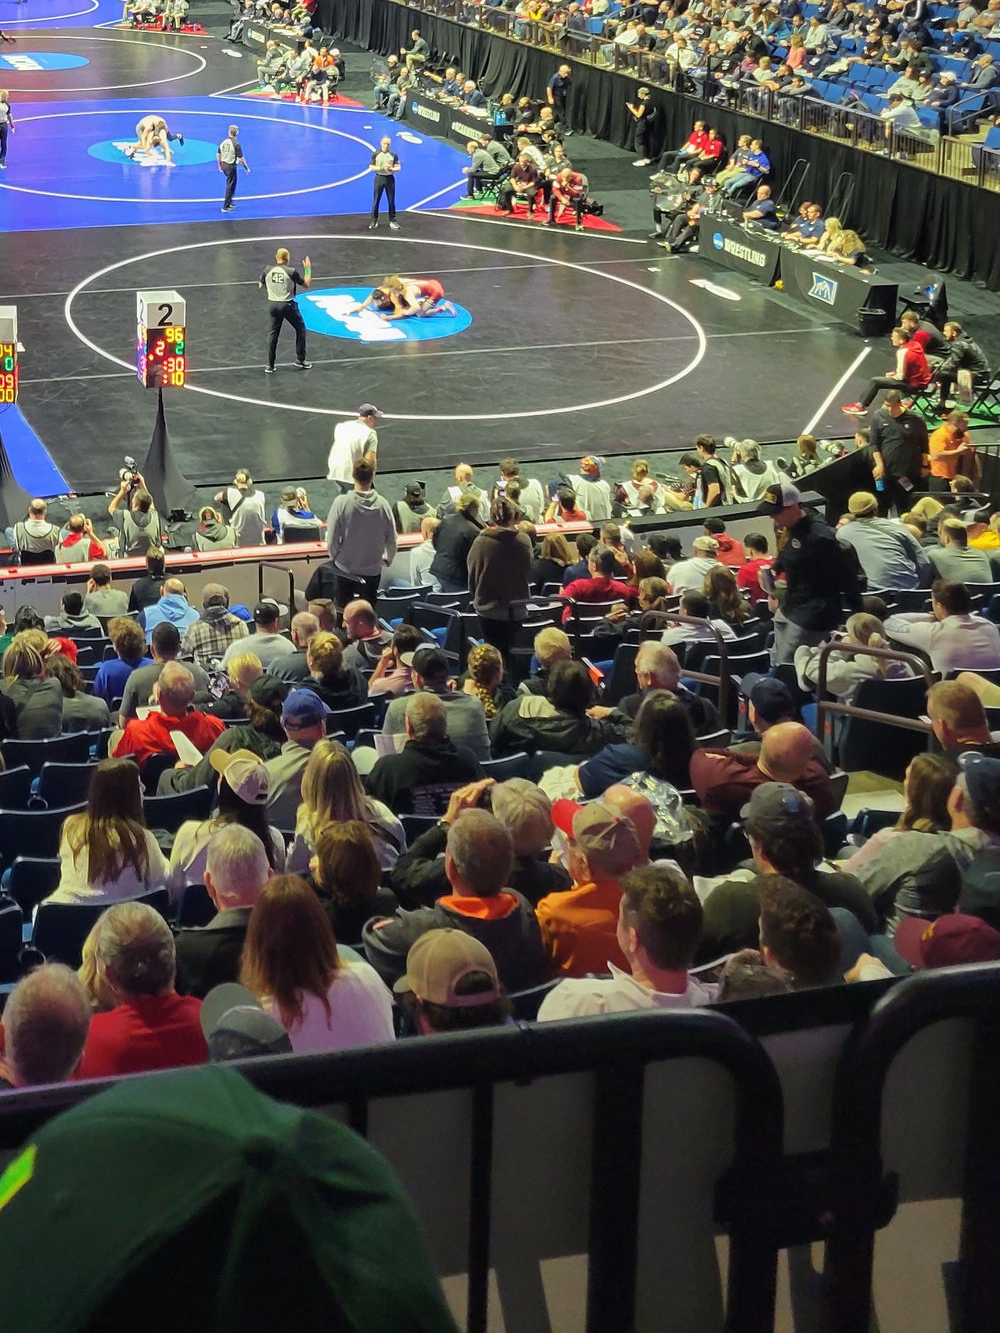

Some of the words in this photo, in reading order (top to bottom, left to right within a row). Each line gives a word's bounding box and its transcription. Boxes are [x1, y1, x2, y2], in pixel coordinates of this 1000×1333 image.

[724, 238, 766, 267] WRESTLING
[272, 273, 284, 283] 42
[157, 303, 173, 327] 2
[165, 327, 184, 343] 96
[155, 341, 165, 356] 2
[175, 341, 184, 355] 2
[4, 356, 14, 371] 0
